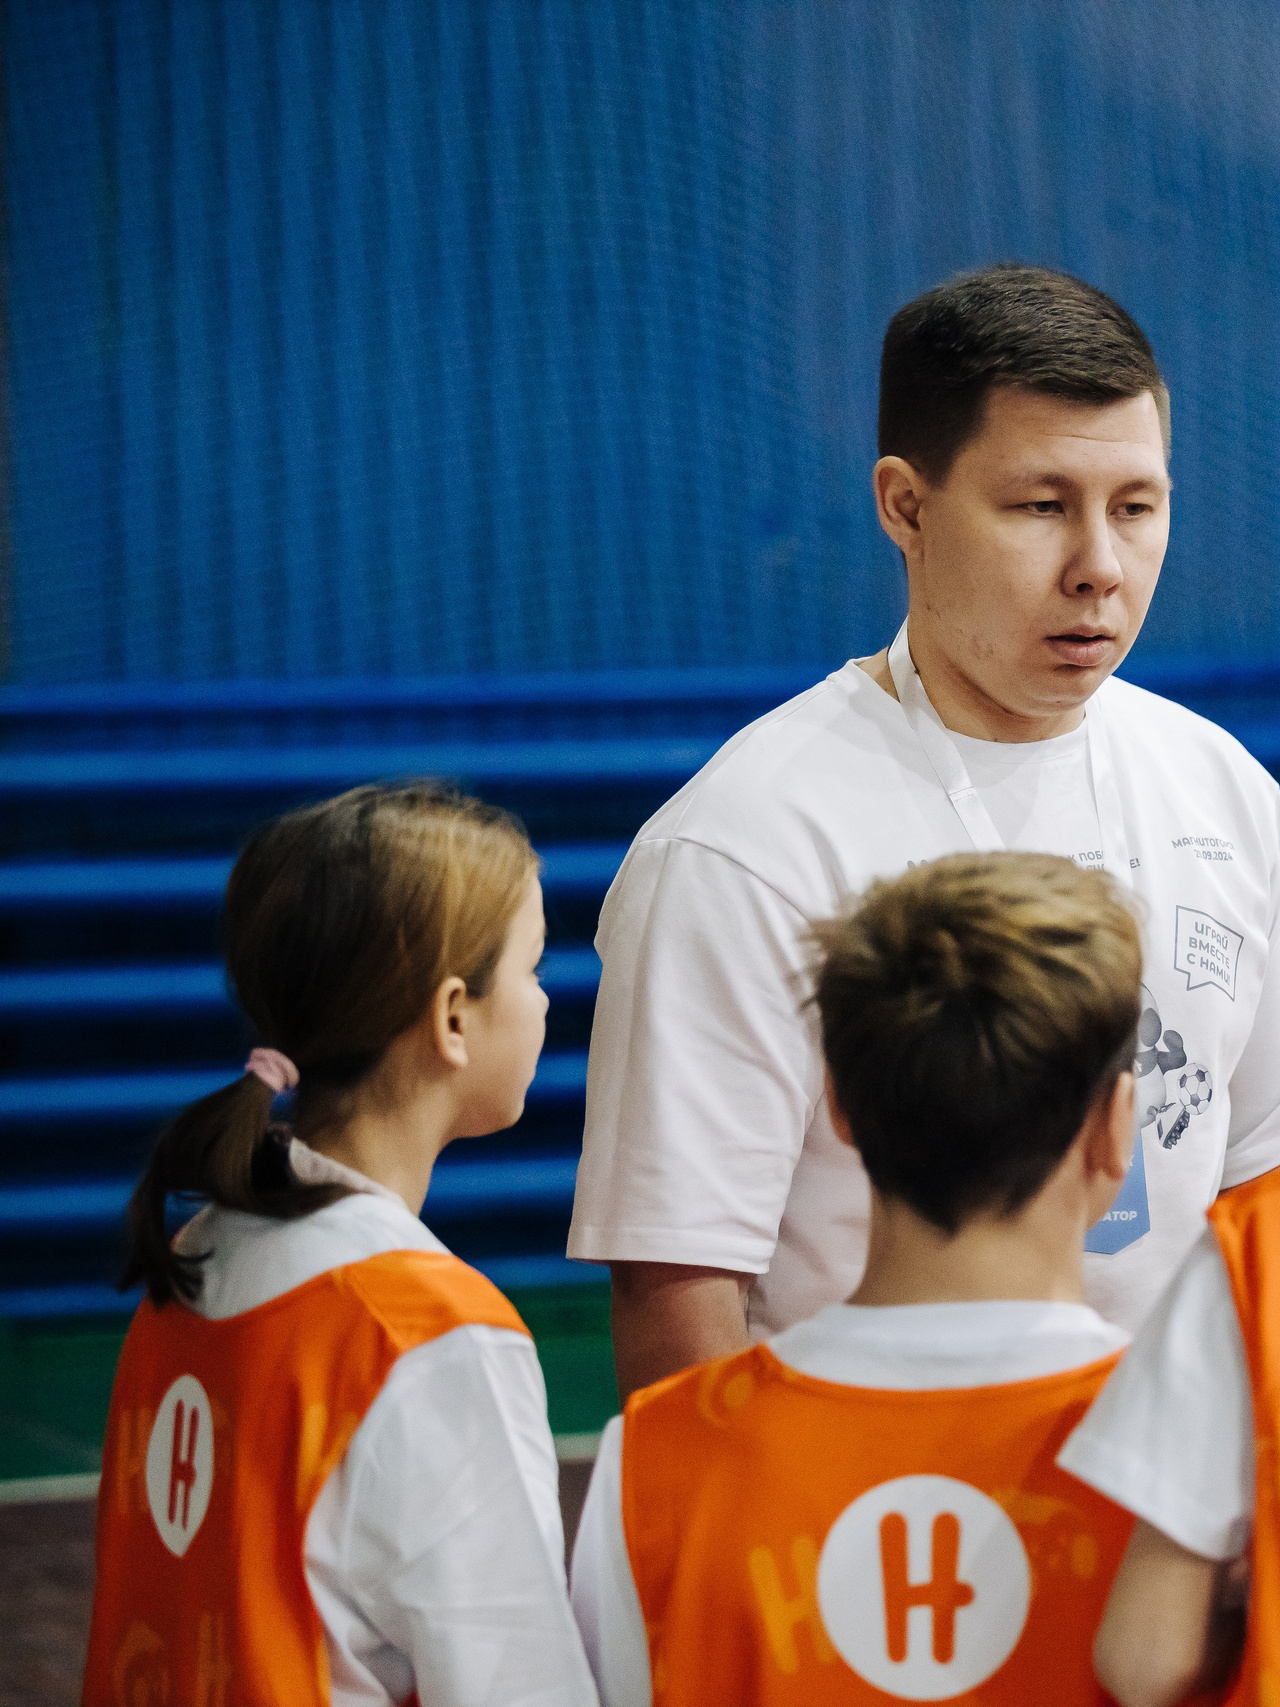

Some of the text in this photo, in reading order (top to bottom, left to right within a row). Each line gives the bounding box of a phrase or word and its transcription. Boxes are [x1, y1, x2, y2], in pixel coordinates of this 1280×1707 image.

[1079, 850, 1104, 862] ПОБ
[1129, 858, 1141, 869] Е!
[1195, 921, 1228, 951] ИГРАЙ
[1189, 936, 1230, 969] ВМЕСТЕ
[1187, 952, 1230, 986] С НАМИ!
[1102, 1210, 1138, 1221] АТОР
